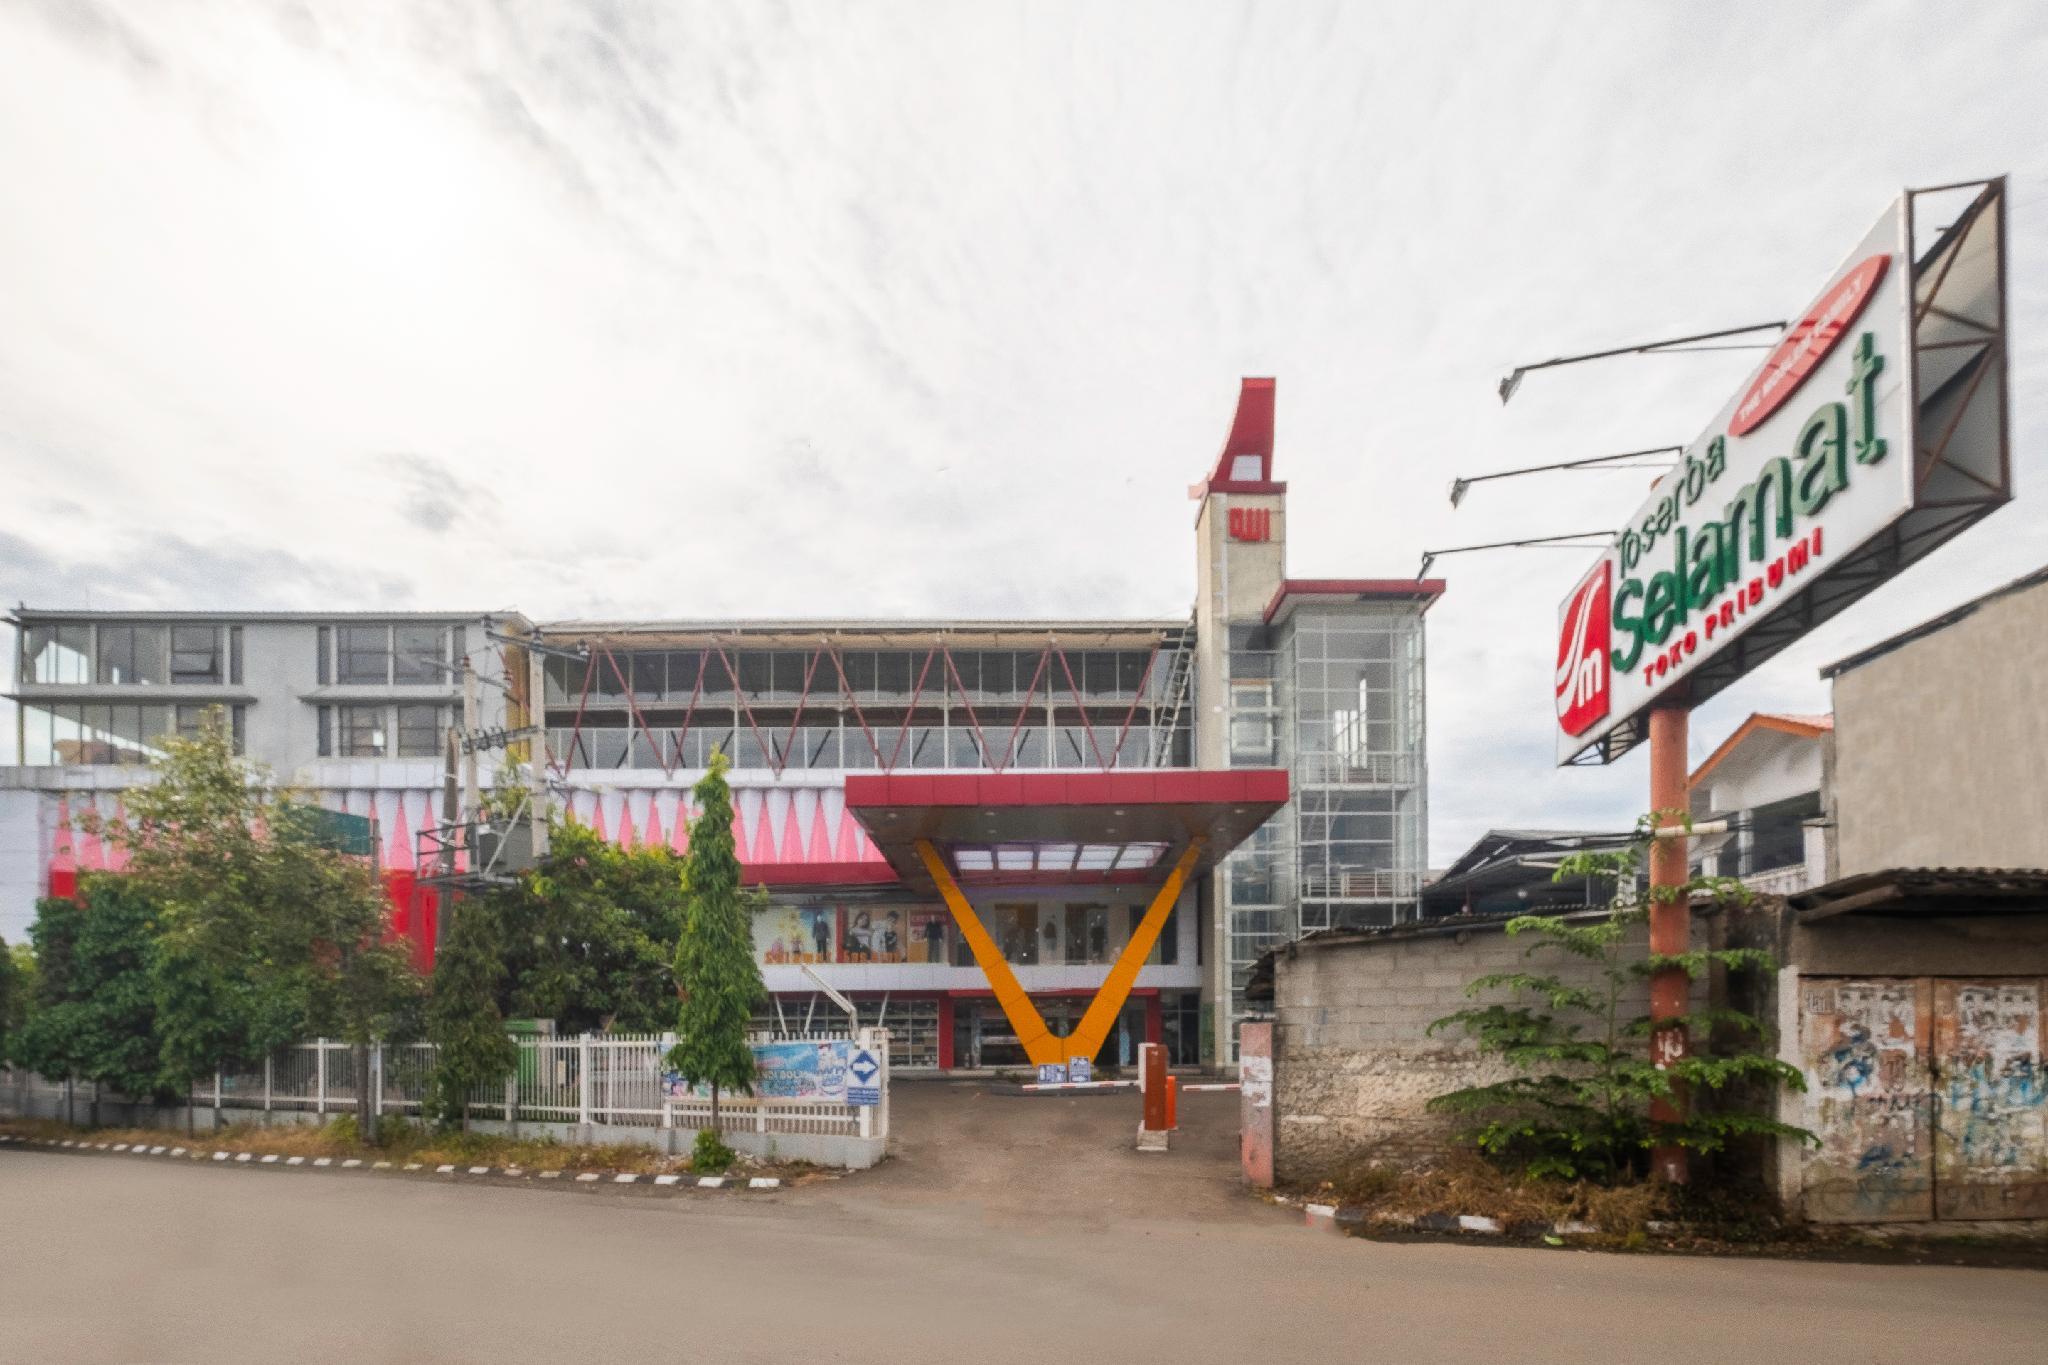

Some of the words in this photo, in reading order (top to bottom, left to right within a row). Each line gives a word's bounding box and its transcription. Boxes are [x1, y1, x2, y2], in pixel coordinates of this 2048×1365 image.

[1611, 332, 1888, 673] Selamat
[1615, 434, 1726, 579] Toserba
[1643, 631, 1697, 687] TOKO
[1705, 526, 1823, 640] PRIBUMI
